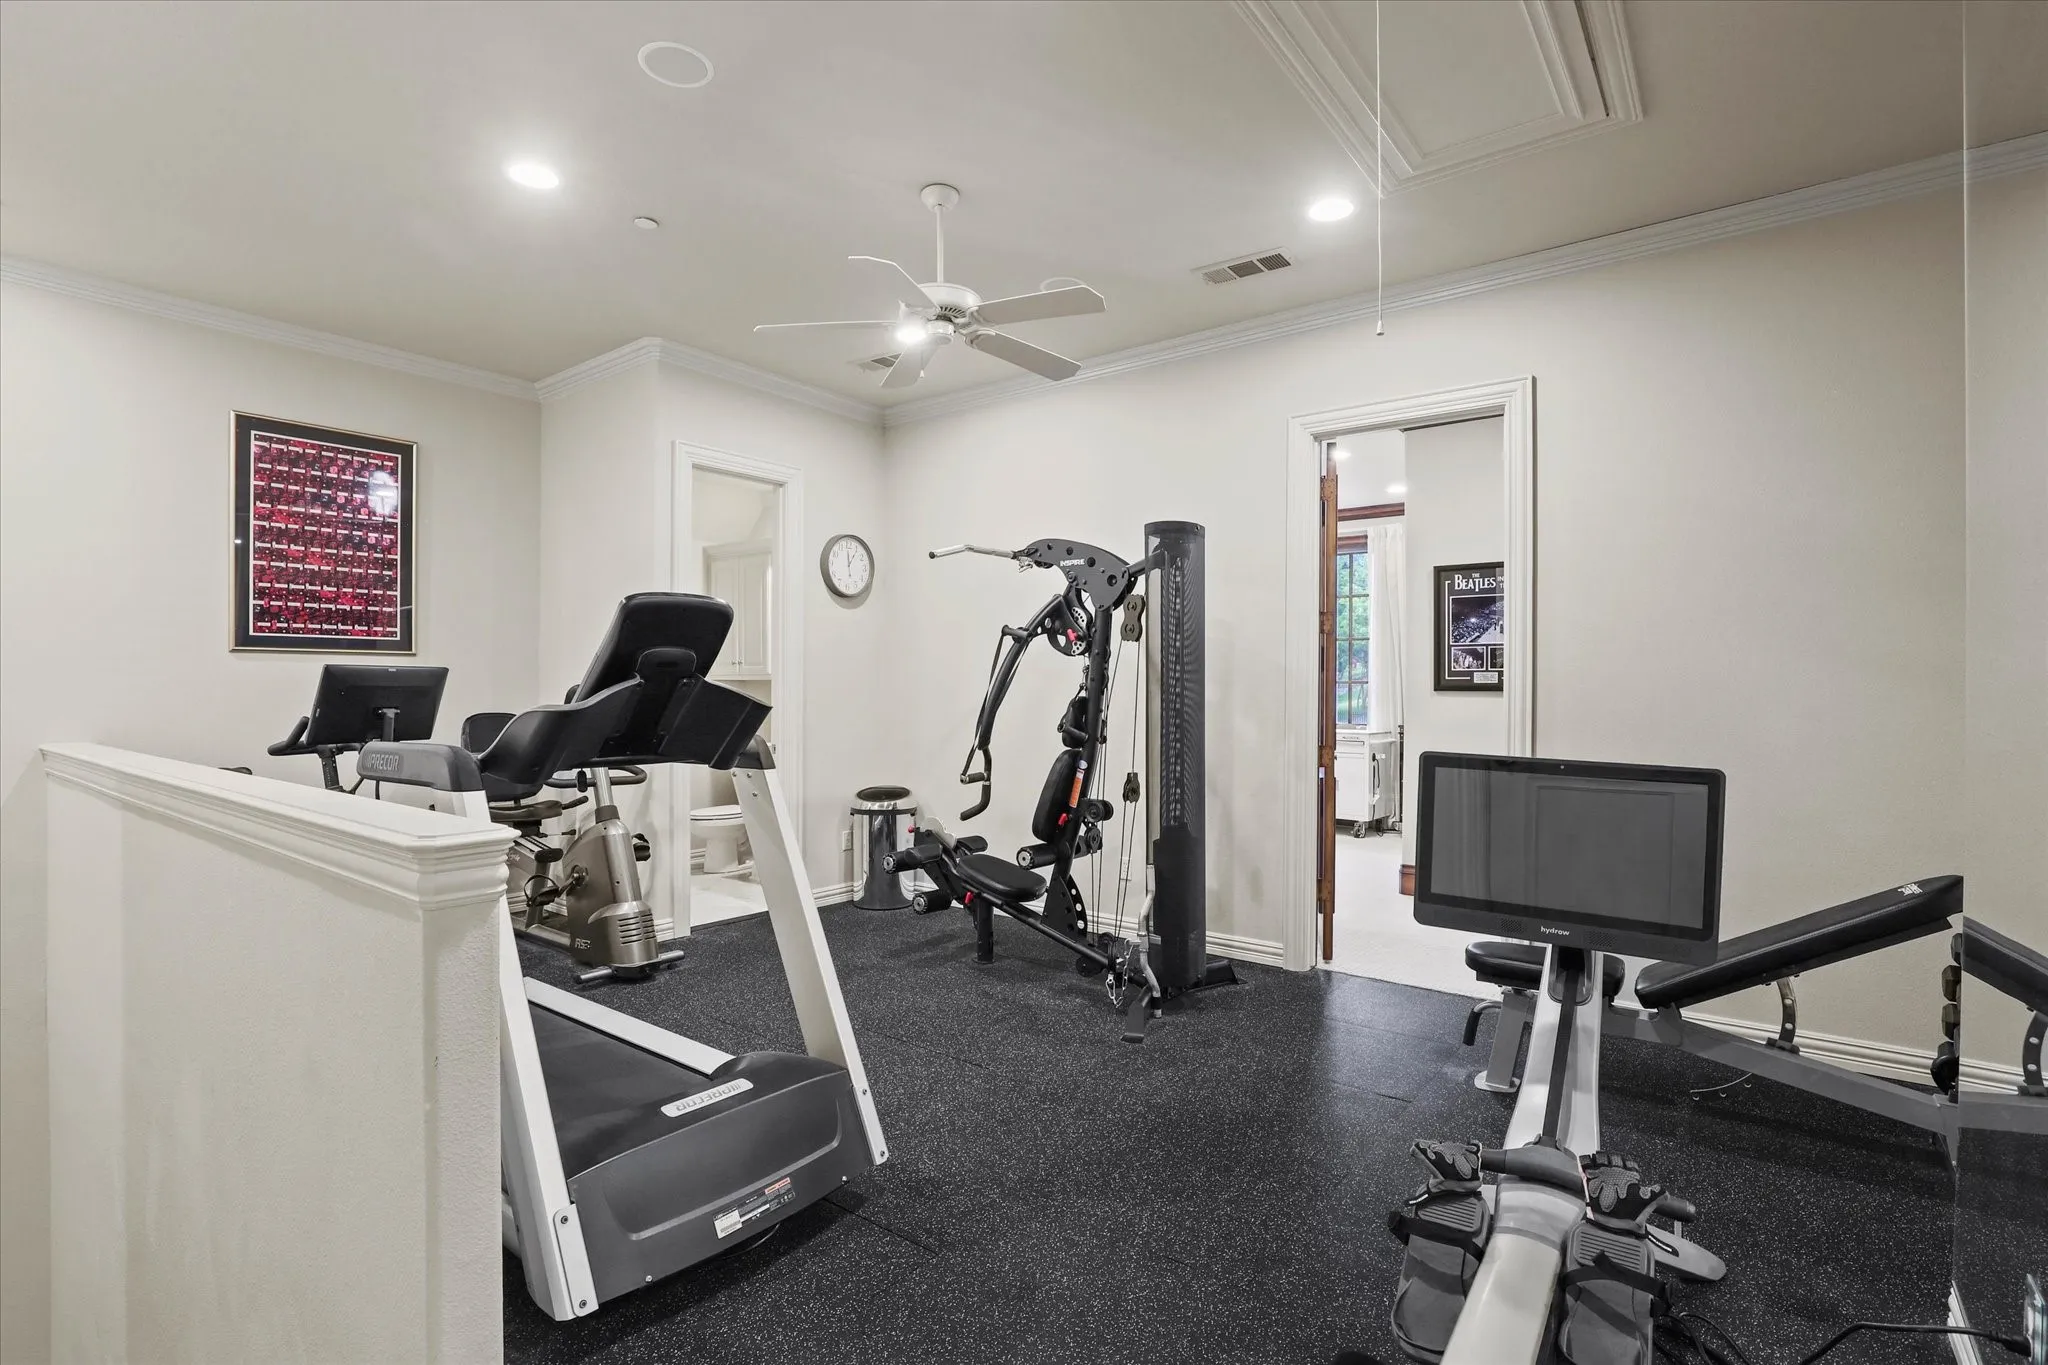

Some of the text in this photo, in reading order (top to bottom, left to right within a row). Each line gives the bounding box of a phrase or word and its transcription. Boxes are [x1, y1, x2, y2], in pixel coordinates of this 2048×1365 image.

[1454, 573, 1497, 592] BEATLES
[370, 753, 400, 771] PRECOR
[1540, 926, 1570, 936] hydrow
[676, 1084, 734, 1112] PRECOR
